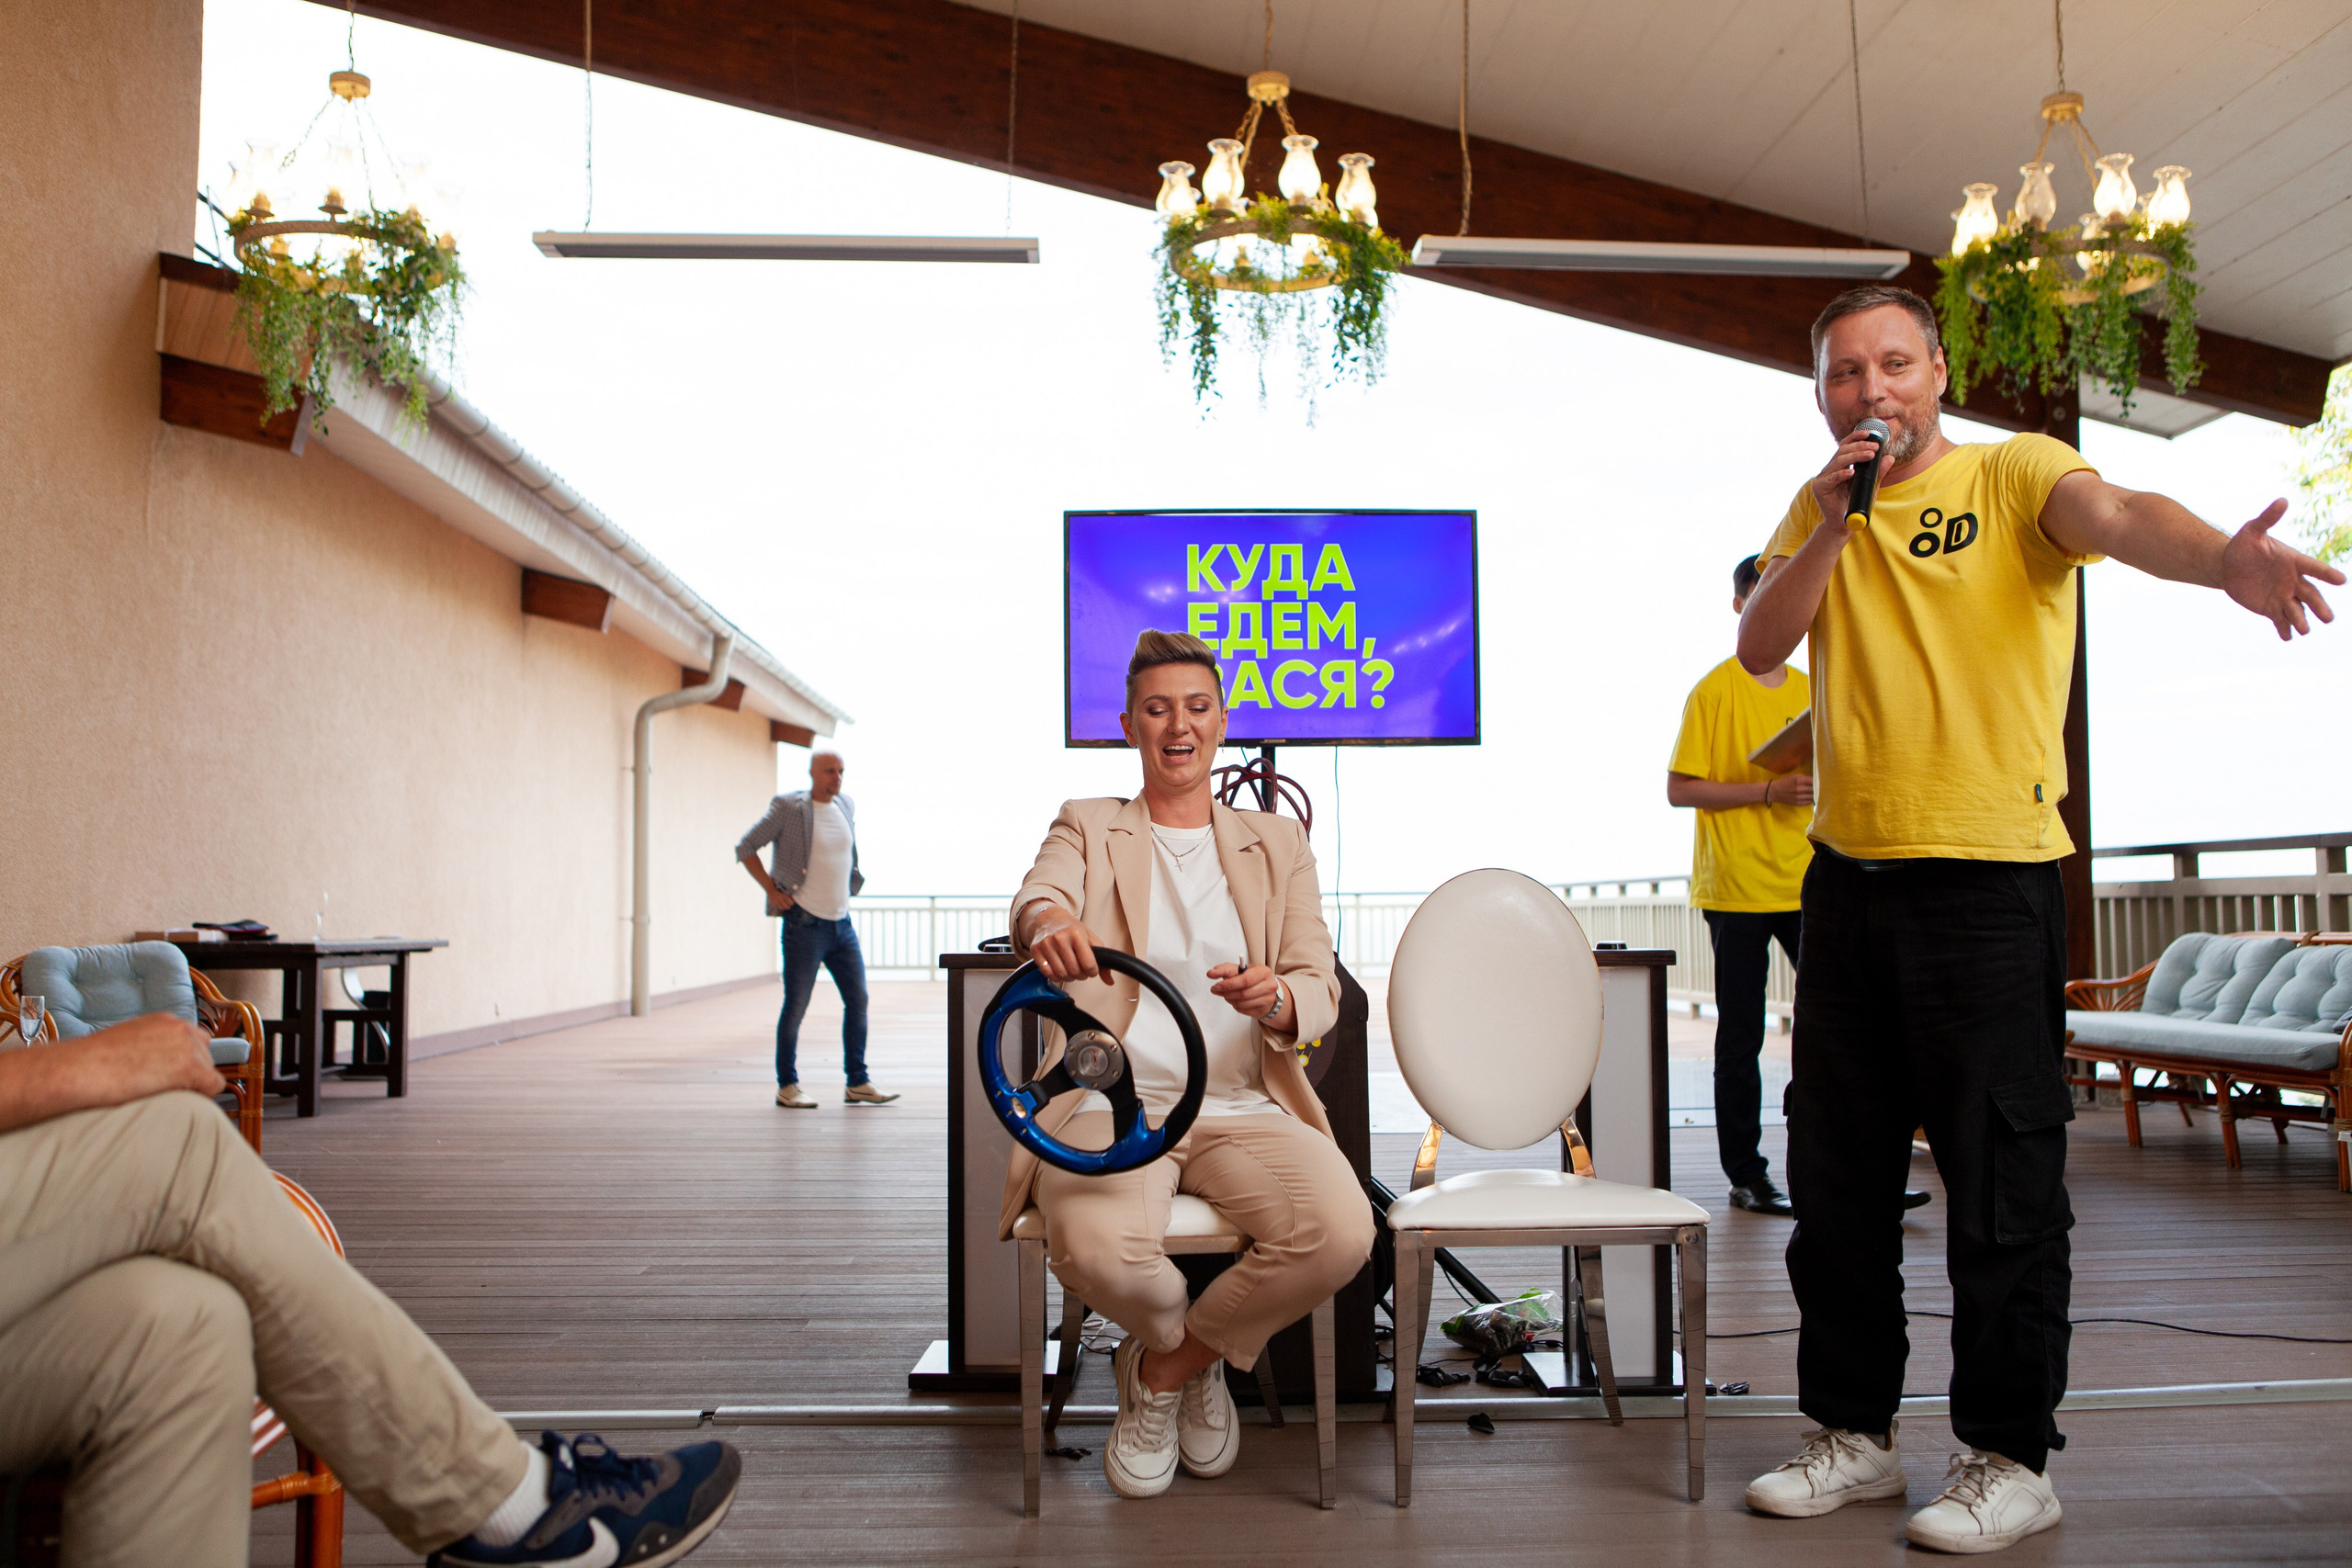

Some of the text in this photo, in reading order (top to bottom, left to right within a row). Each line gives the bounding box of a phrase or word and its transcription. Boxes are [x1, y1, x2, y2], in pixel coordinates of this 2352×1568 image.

[1187, 544, 1356, 600] КУДА
[1187, 602, 1376, 659] ЕДЕМ,
[1215, 659, 1395, 709] АСЯ?
